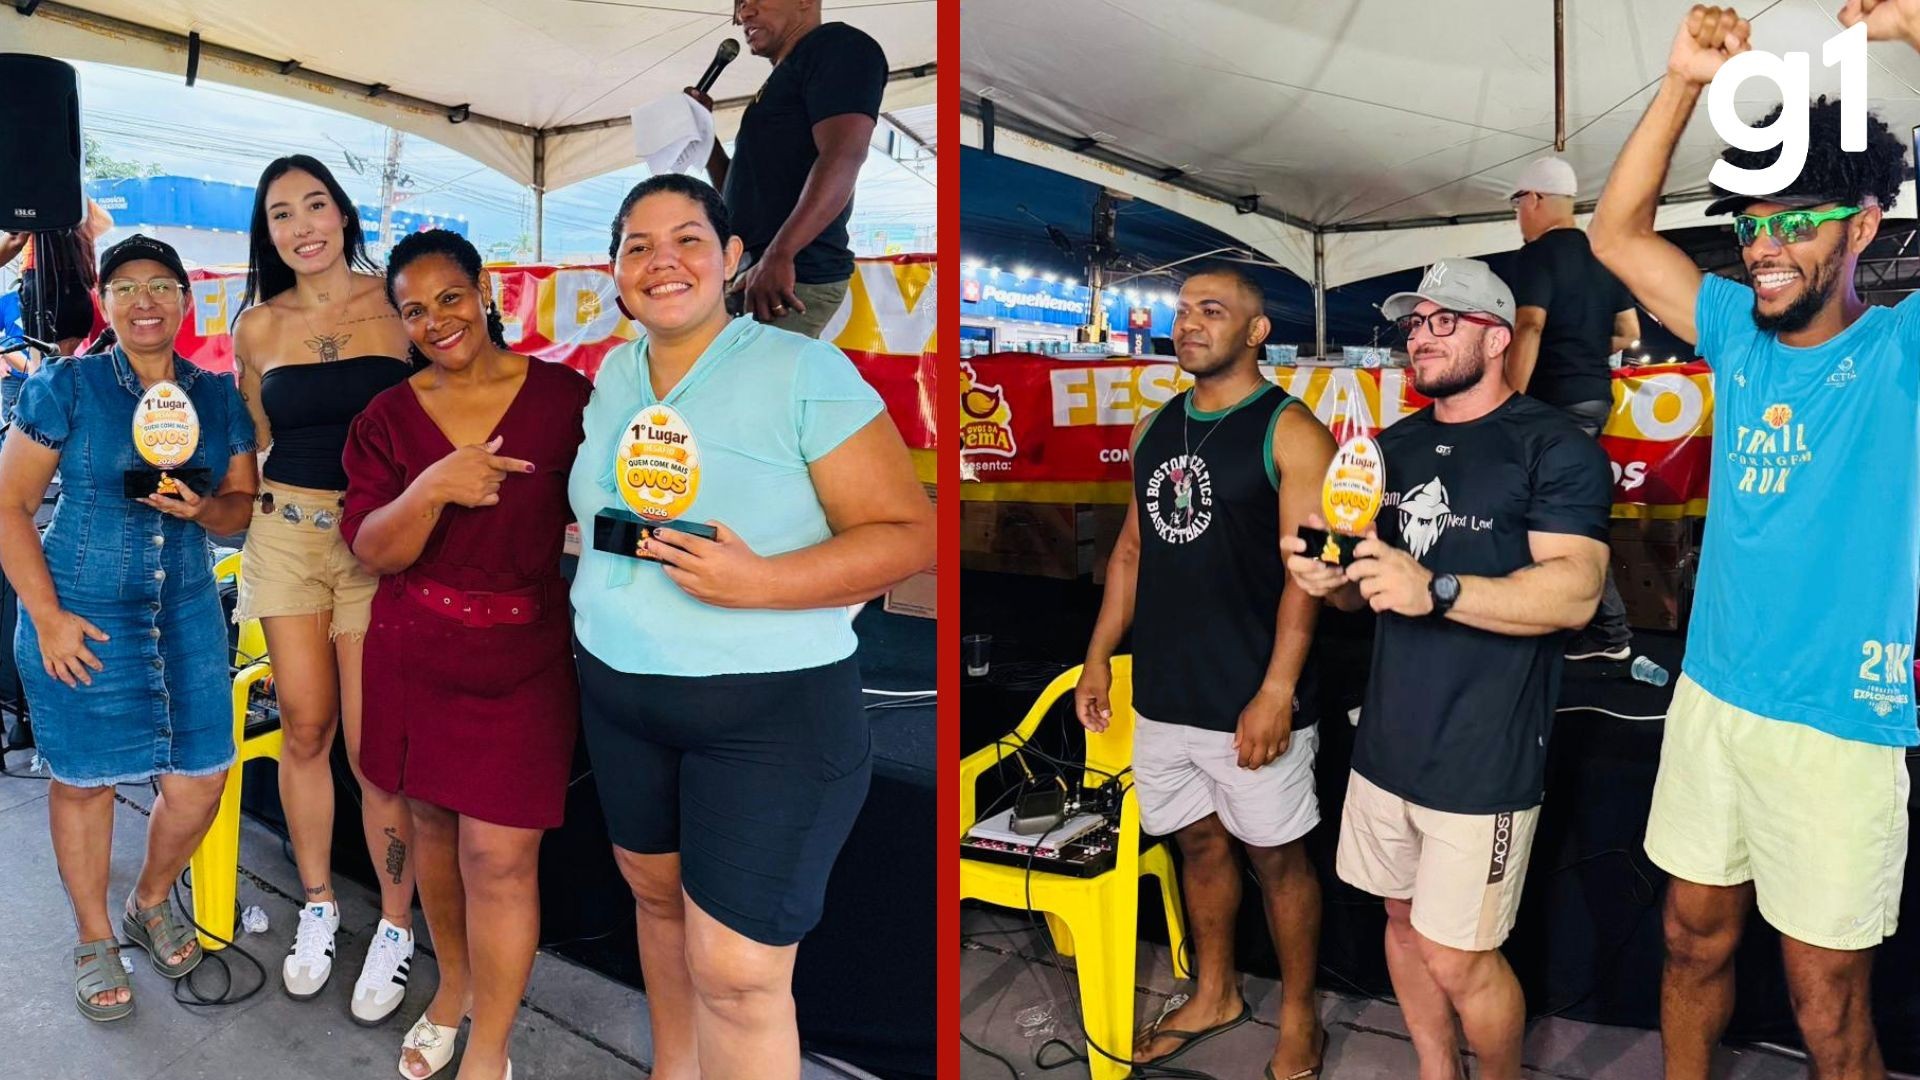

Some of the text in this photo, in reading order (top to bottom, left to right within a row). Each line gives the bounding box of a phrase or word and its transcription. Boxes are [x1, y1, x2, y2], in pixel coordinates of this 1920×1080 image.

[157, 399, 186, 410] Lugar
[1051, 364, 1424, 429] FESVAL
[144, 430, 189, 446] OVOS
[648, 427, 688, 444] Lugar
[1737, 424, 1808, 454] TRAIL
[628, 459, 689, 475] QUEM COME MAIS
[1351, 455, 1377, 469] Lugar
[628, 469, 687, 494] OVOS
[1146, 454, 1212, 507] BOSTON CELTICS
[1738, 466, 1791, 494] RUN
[643, 506, 668, 517] 2026
[1146, 500, 1212, 544] BASKETBALL
[1446, 513, 1467, 528] Next
[1859, 640, 1912, 684] 21K
